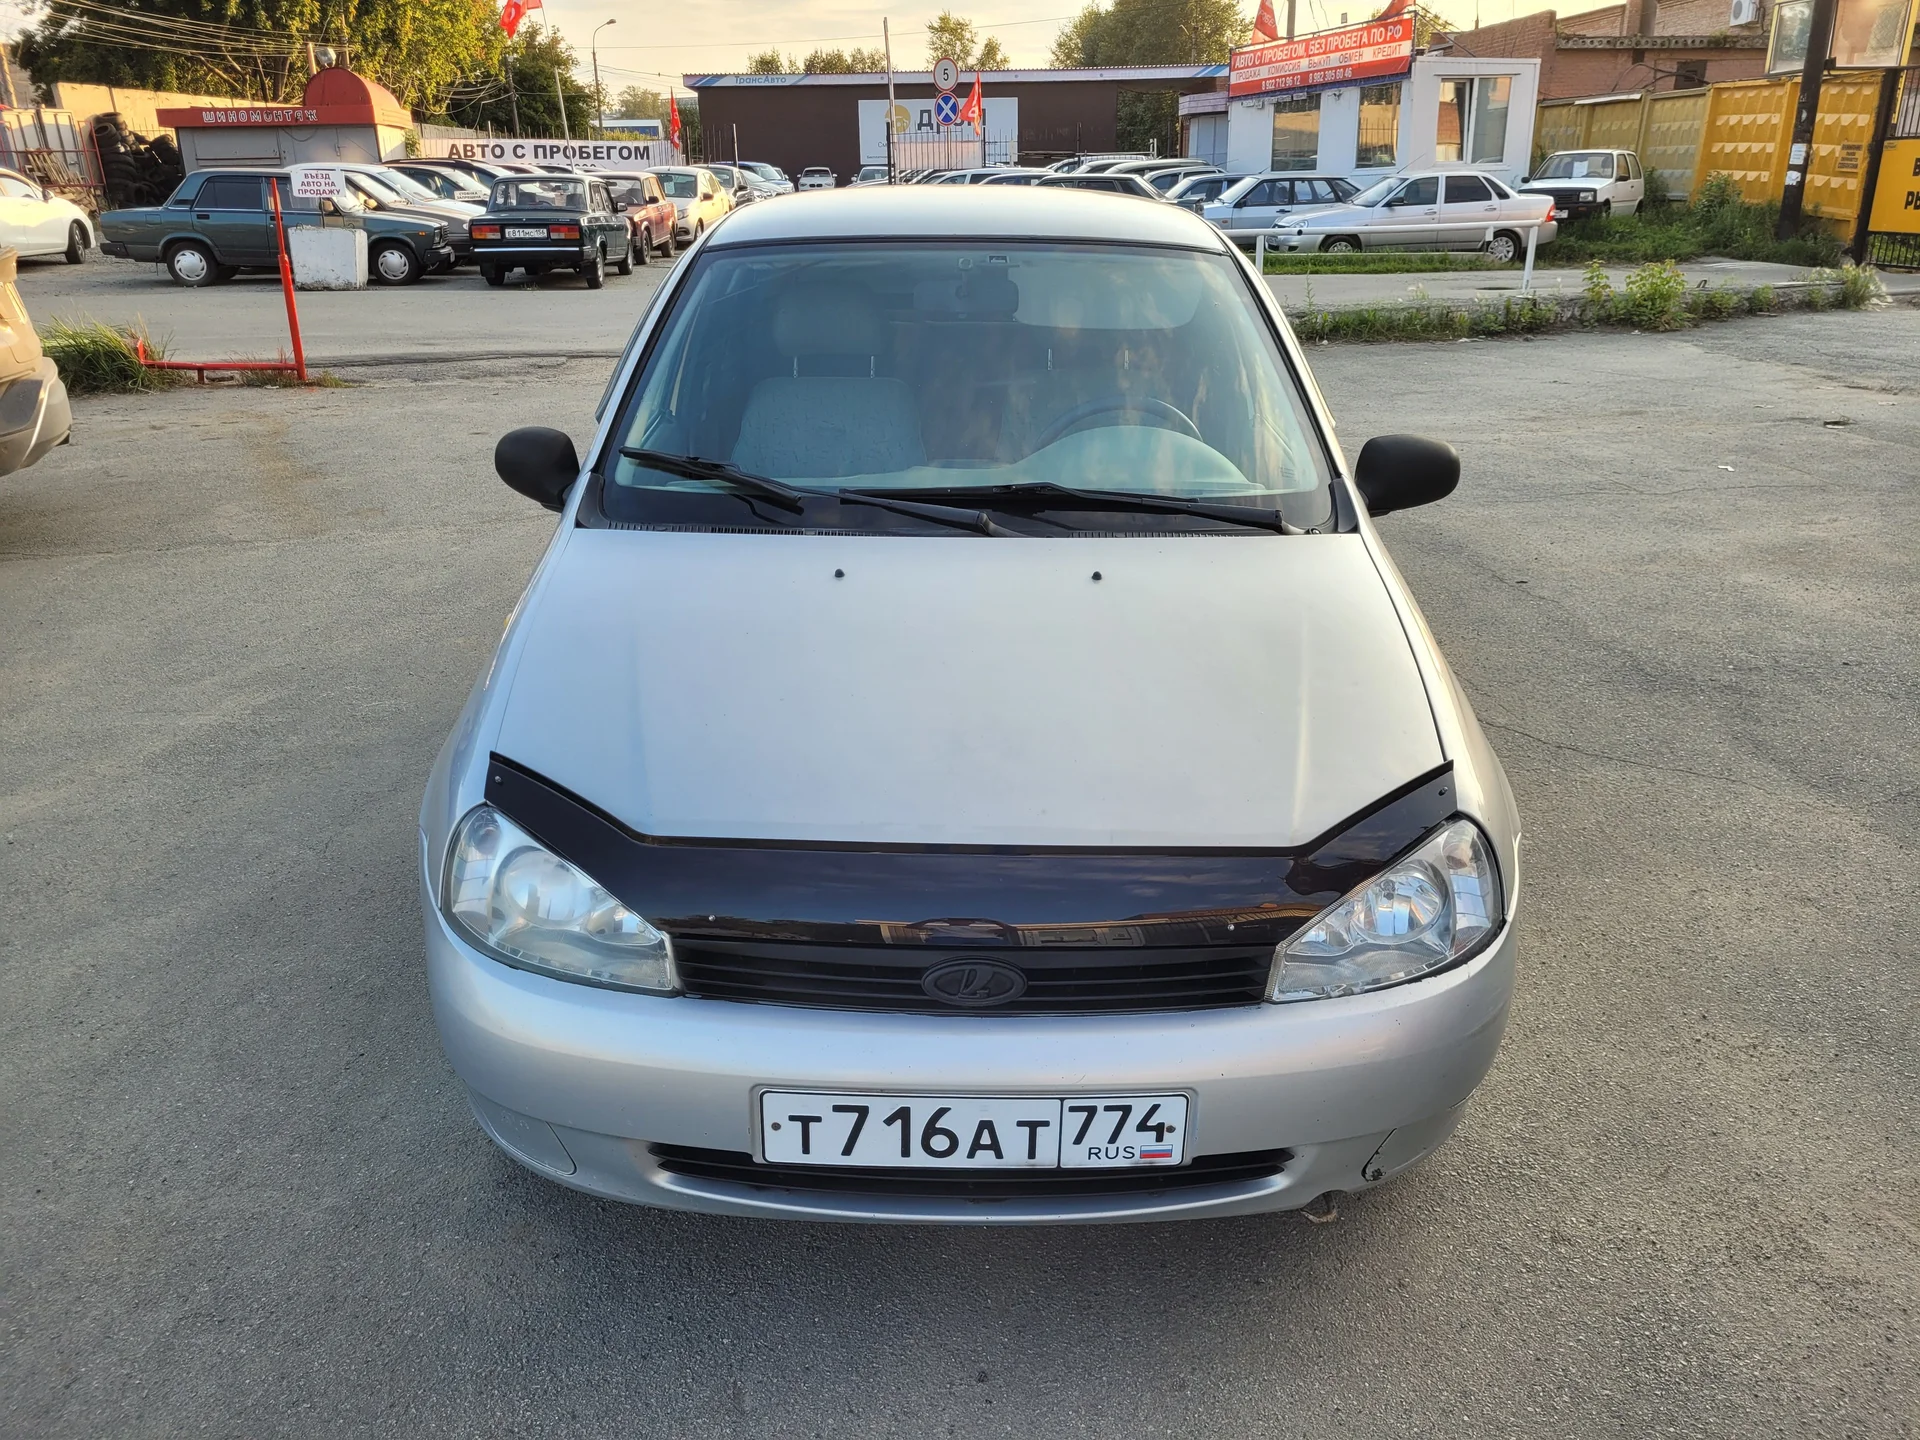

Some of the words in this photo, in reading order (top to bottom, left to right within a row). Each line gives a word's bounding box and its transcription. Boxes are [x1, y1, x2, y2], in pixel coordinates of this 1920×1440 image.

[1235, 53, 1254, 69] АВТО
[1255, 52, 1261, 65] С
[1262, 42, 1306, 64] ПРОБЕГОМ,
[1309, 38, 1325, 54] БЕЗ
[1327, 30, 1368, 51] ПРОБЕГА
[1370, 27, 1385, 44] ПО
[1387, 25, 1403, 41] РФ
[1236, 68, 1261, 81] ПРОДАЖА
[1267, 61, 1301, 76] КОМИССИЯ
[1308, 55, 1331, 69] ВЫКУП
[1338, 50, 1364, 64] ОБМЕН
[1372, 44, 1402, 59] КРЕДИТ
[734, 75, 787, 85] ТрансАвто
[942, 68, 950, 81] 5
[1308, 73, 1313, 83] 8
[1262, 80, 1266, 90] 8
[1275, 77, 1286, 88] 712
[1294, 75, 1301, 85] 12
[448, 143, 505, 159] АВТО
[512, 144, 527, 160] С
[534, 144, 651, 161] ПРОБЕГОМ
[298, 188, 341, 196] ПРОДАЖУ
[788, 1104, 1051, 1160] Т716АТ
[1068, 1103, 1166, 1146] 774
[1087, 1145, 1135, 1160] RUS
